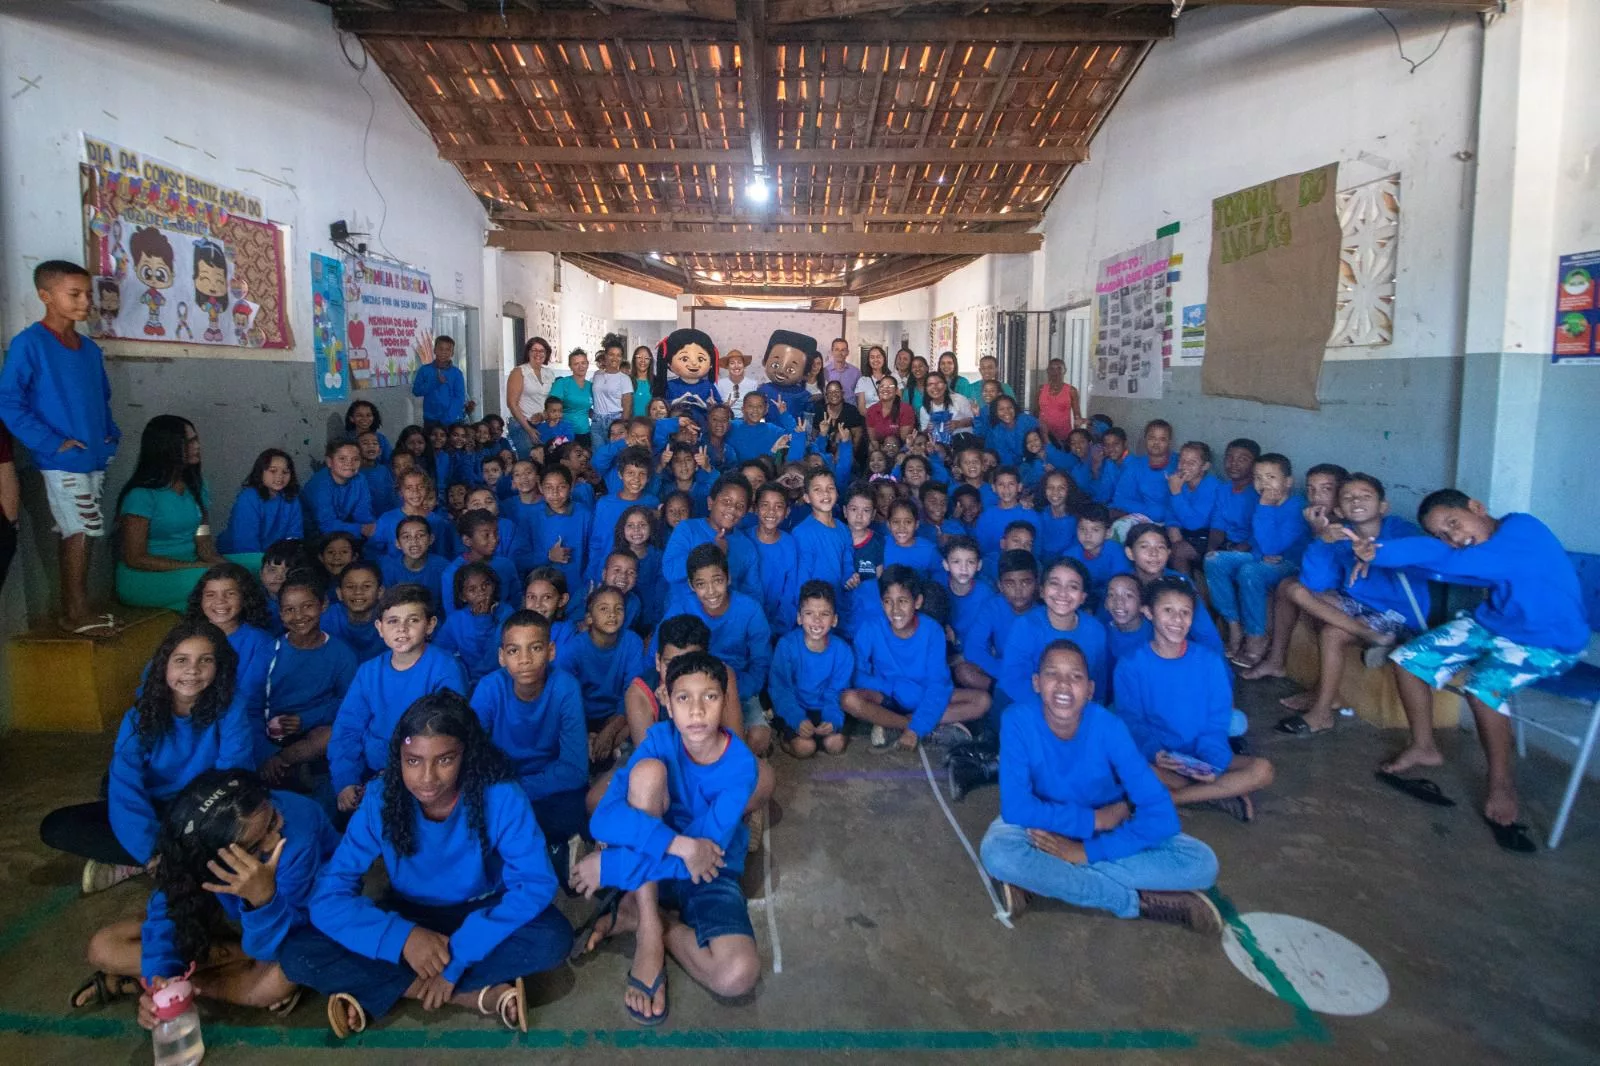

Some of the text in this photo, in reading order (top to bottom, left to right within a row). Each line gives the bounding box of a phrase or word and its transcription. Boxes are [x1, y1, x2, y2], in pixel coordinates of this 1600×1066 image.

[87, 141, 113, 165] DIA
[119, 149, 140, 174] DA
[247, 199, 262, 218] DO
[199, 788, 226, 813] LOVE
